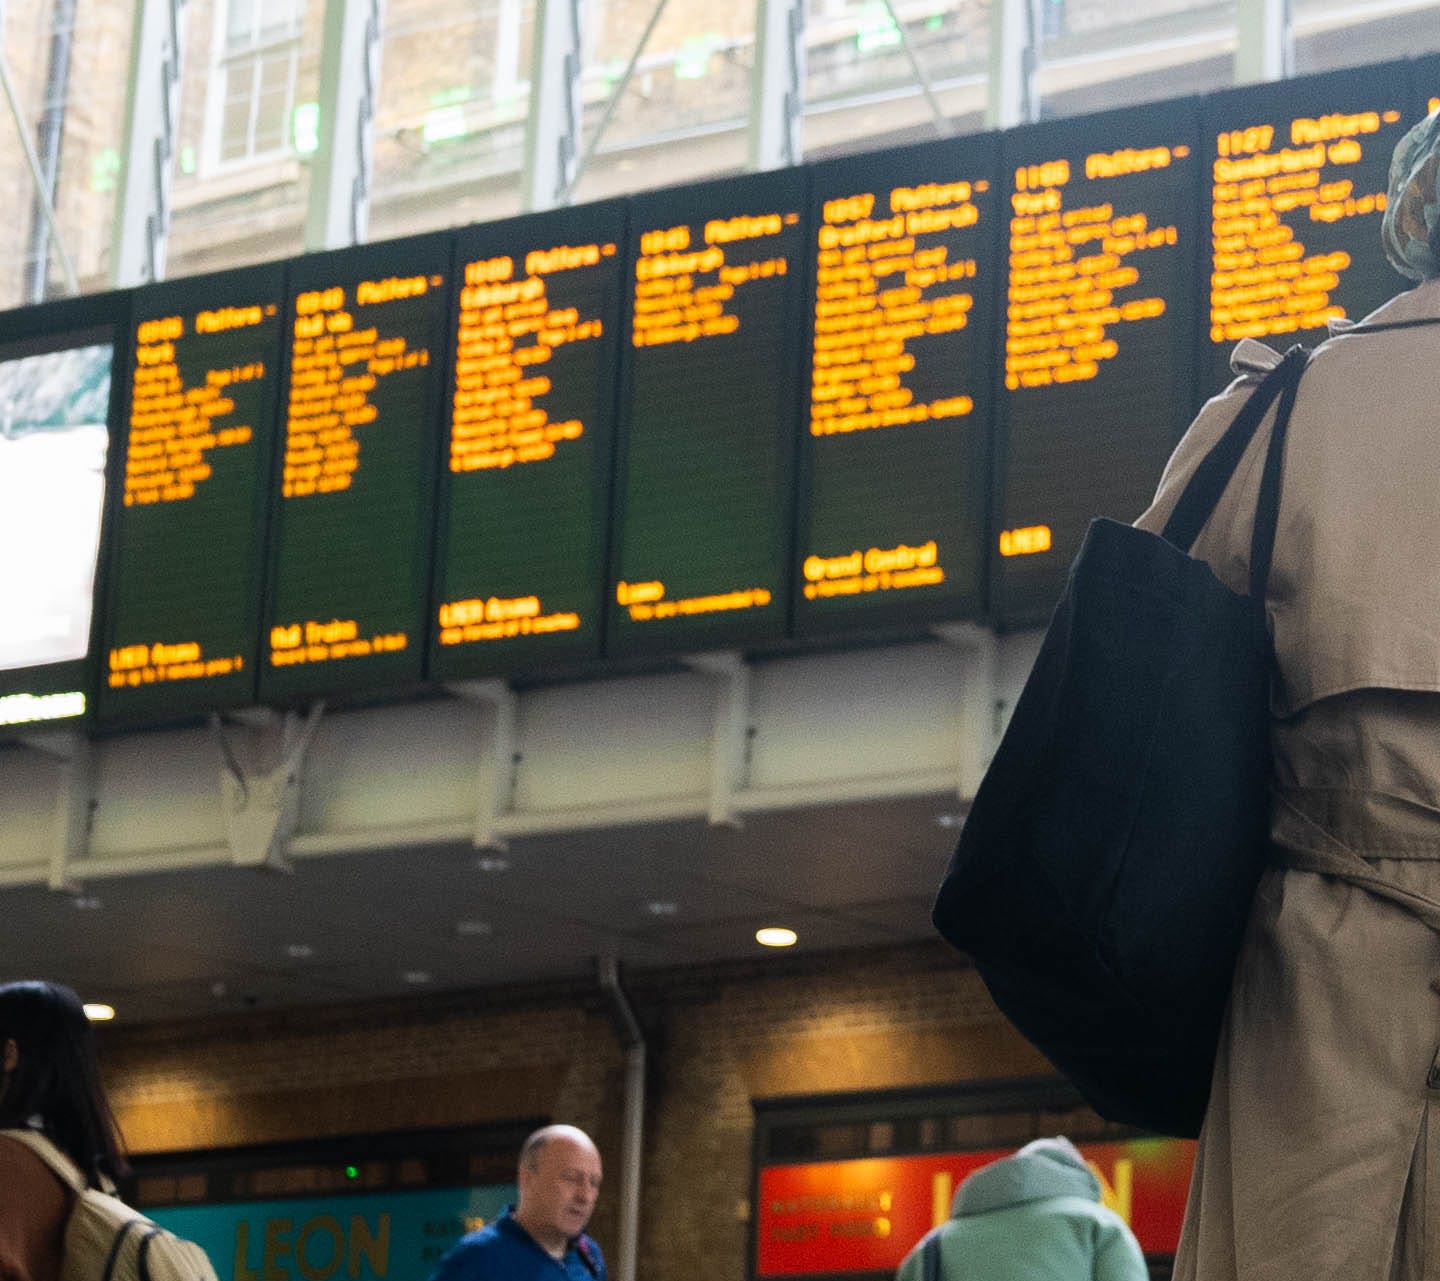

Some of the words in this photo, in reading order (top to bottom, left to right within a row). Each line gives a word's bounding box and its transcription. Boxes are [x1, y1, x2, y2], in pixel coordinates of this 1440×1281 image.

[1290, 111, 1380, 145] Platform
[1213, 142, 1326, 183] Sunderland
[804, 550, 863, 581] Grand
[864, 540, 937, 572] Central
